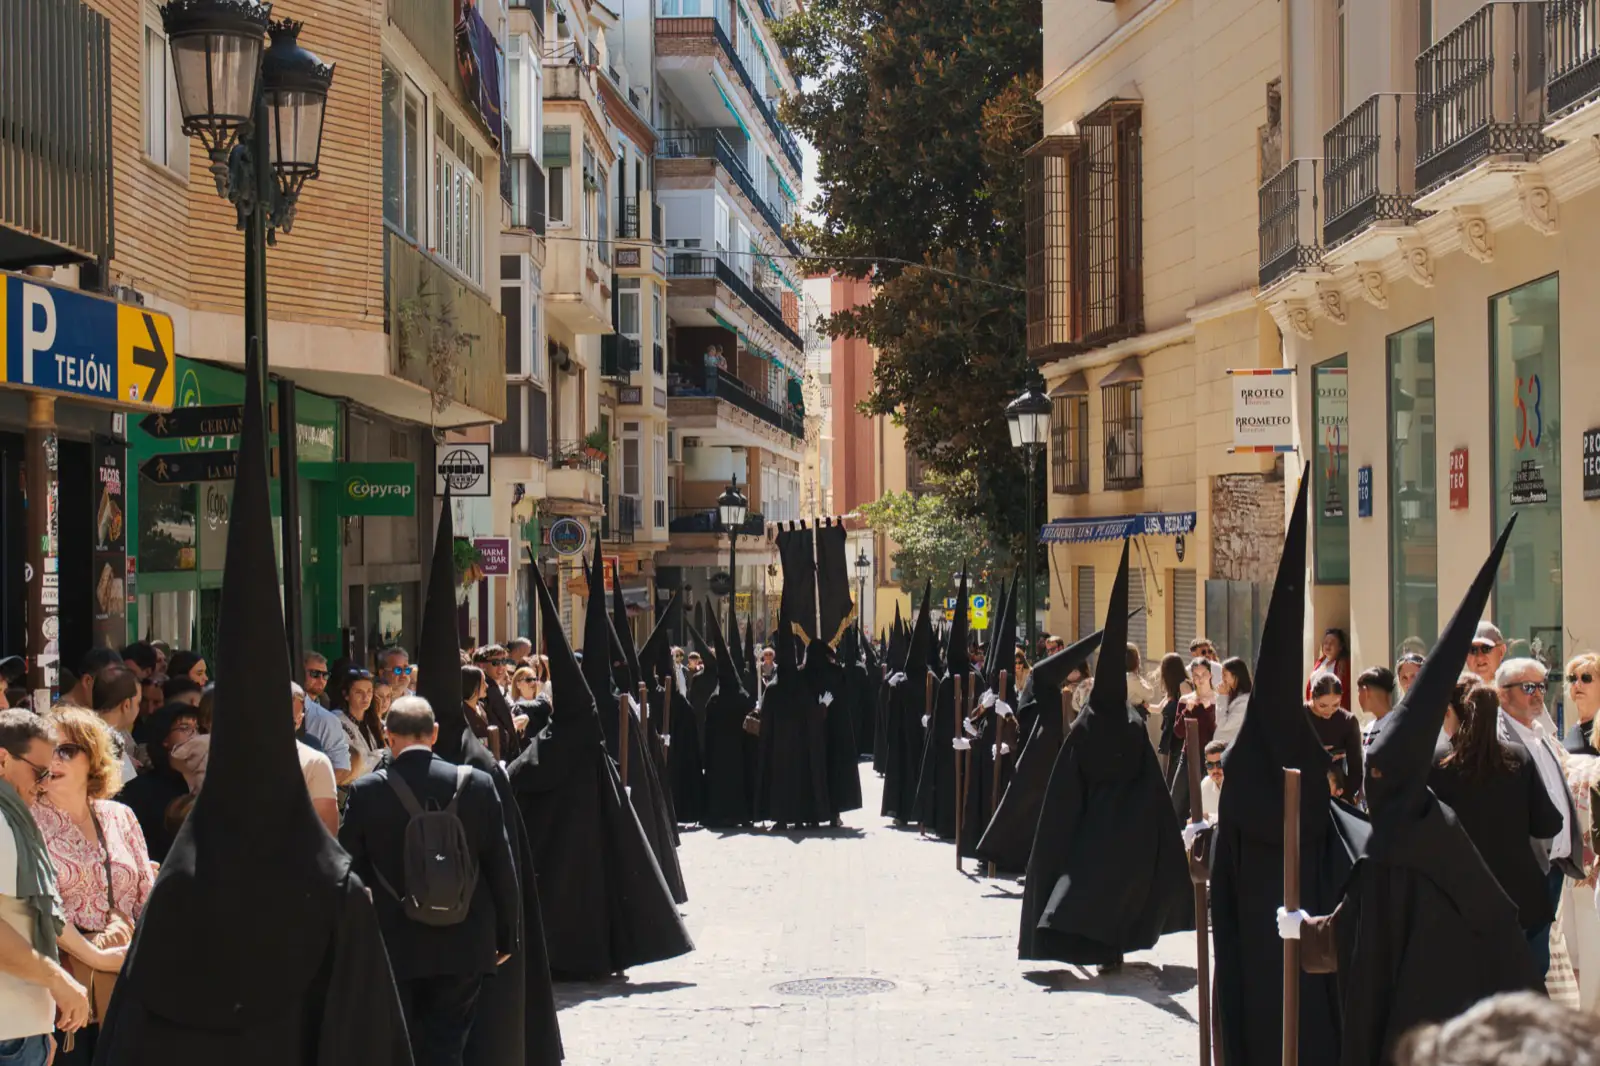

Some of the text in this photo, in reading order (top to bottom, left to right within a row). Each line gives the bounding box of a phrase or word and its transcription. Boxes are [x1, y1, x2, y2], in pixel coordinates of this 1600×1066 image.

[23, 282, 57, 385] P
[54, 353, 111, 392] TEJÓN
[1241, 388, 1284, 404] PROTEO
[201, 415, 241, 434] CERVA
[1235, 416, 1291, 432] PROMETEO
[1450, 453, 1464, 471] PRO
[100, 466, 120, 482] TACOS
[1358, 470, 1369, 484] PRO
[1450, 473, 1464, 489] TEO
[350, 483, 411, 498] copyrap
[1358, 486, 1369, 500] TEO
[1143, 514, 1193, 533] LUSA REGALOS
[481, 548, 504, 557] HARM
[491, 555, 507, 564] BAR
